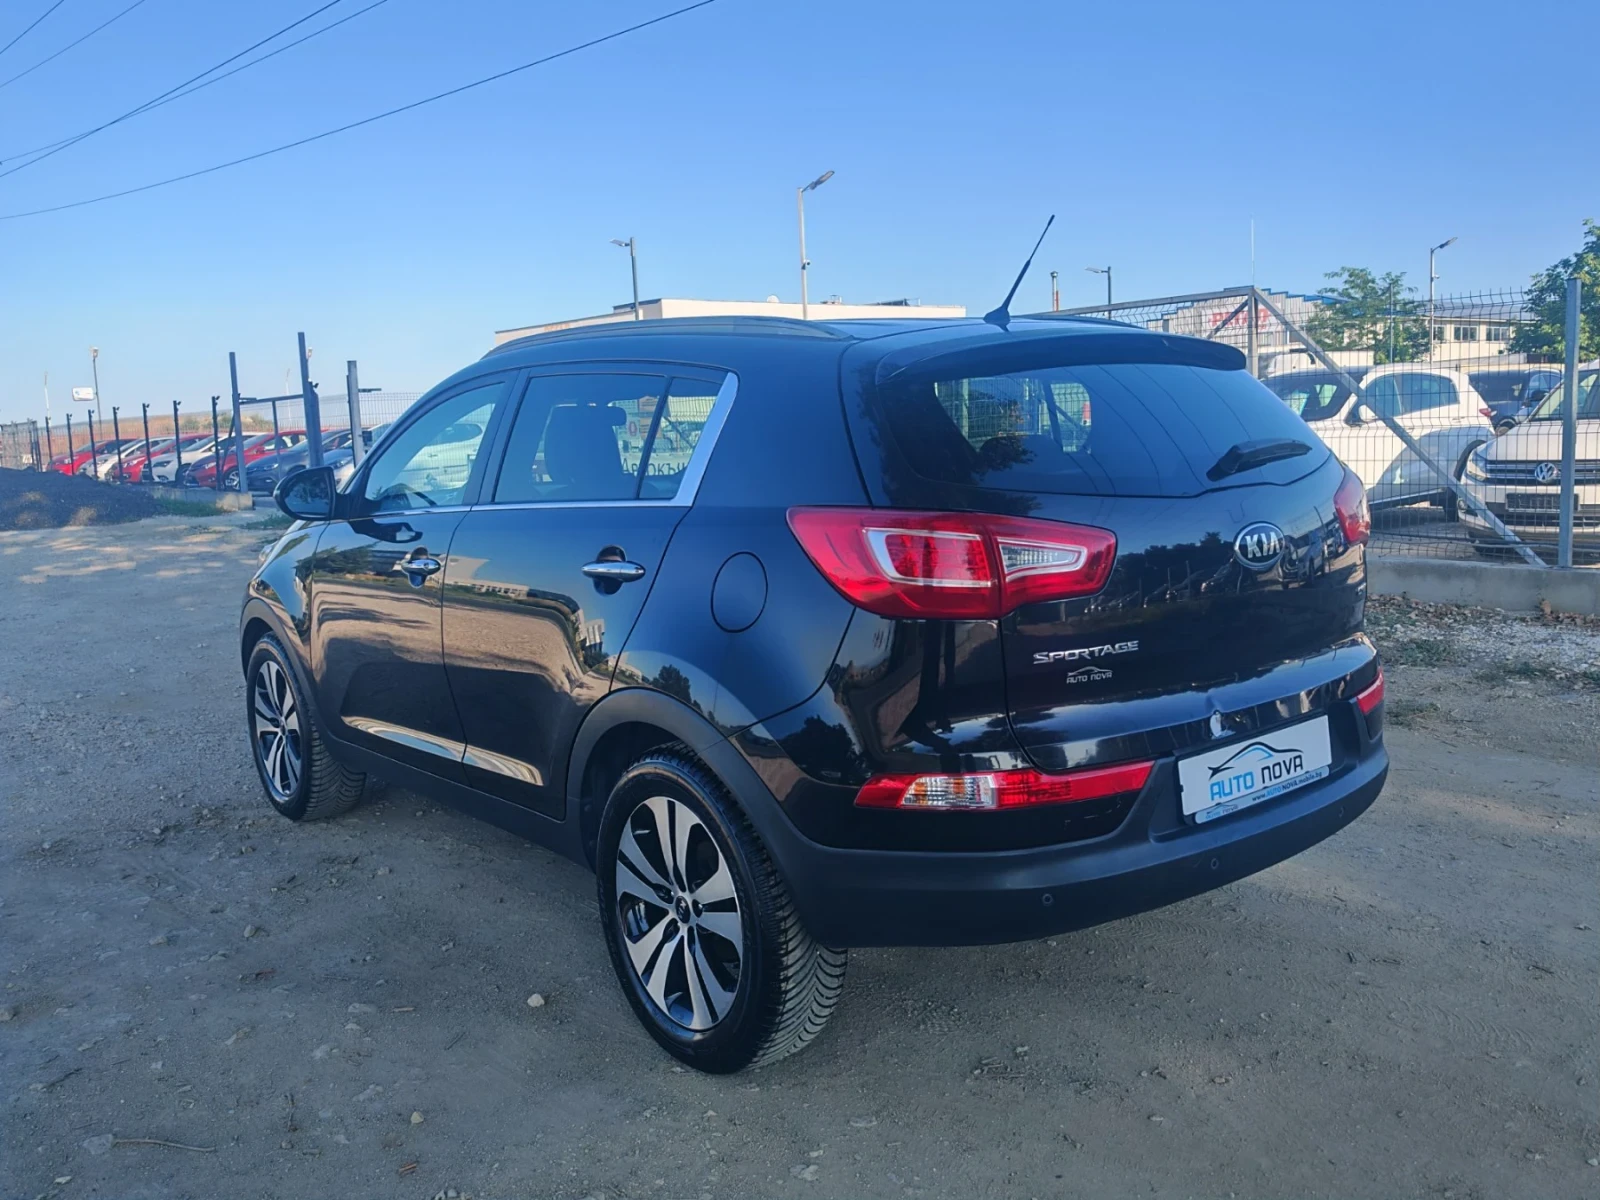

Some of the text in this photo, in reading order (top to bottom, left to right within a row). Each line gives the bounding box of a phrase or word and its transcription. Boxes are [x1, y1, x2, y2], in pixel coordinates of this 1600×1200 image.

[1244, 531, 1281, 559] KIA
[1033, 640, 1139, 664] SPORTAGE
[1066, 674, 1088, 684] AUTO
[1210, 754, 1304, 801] AUTO NOVA
